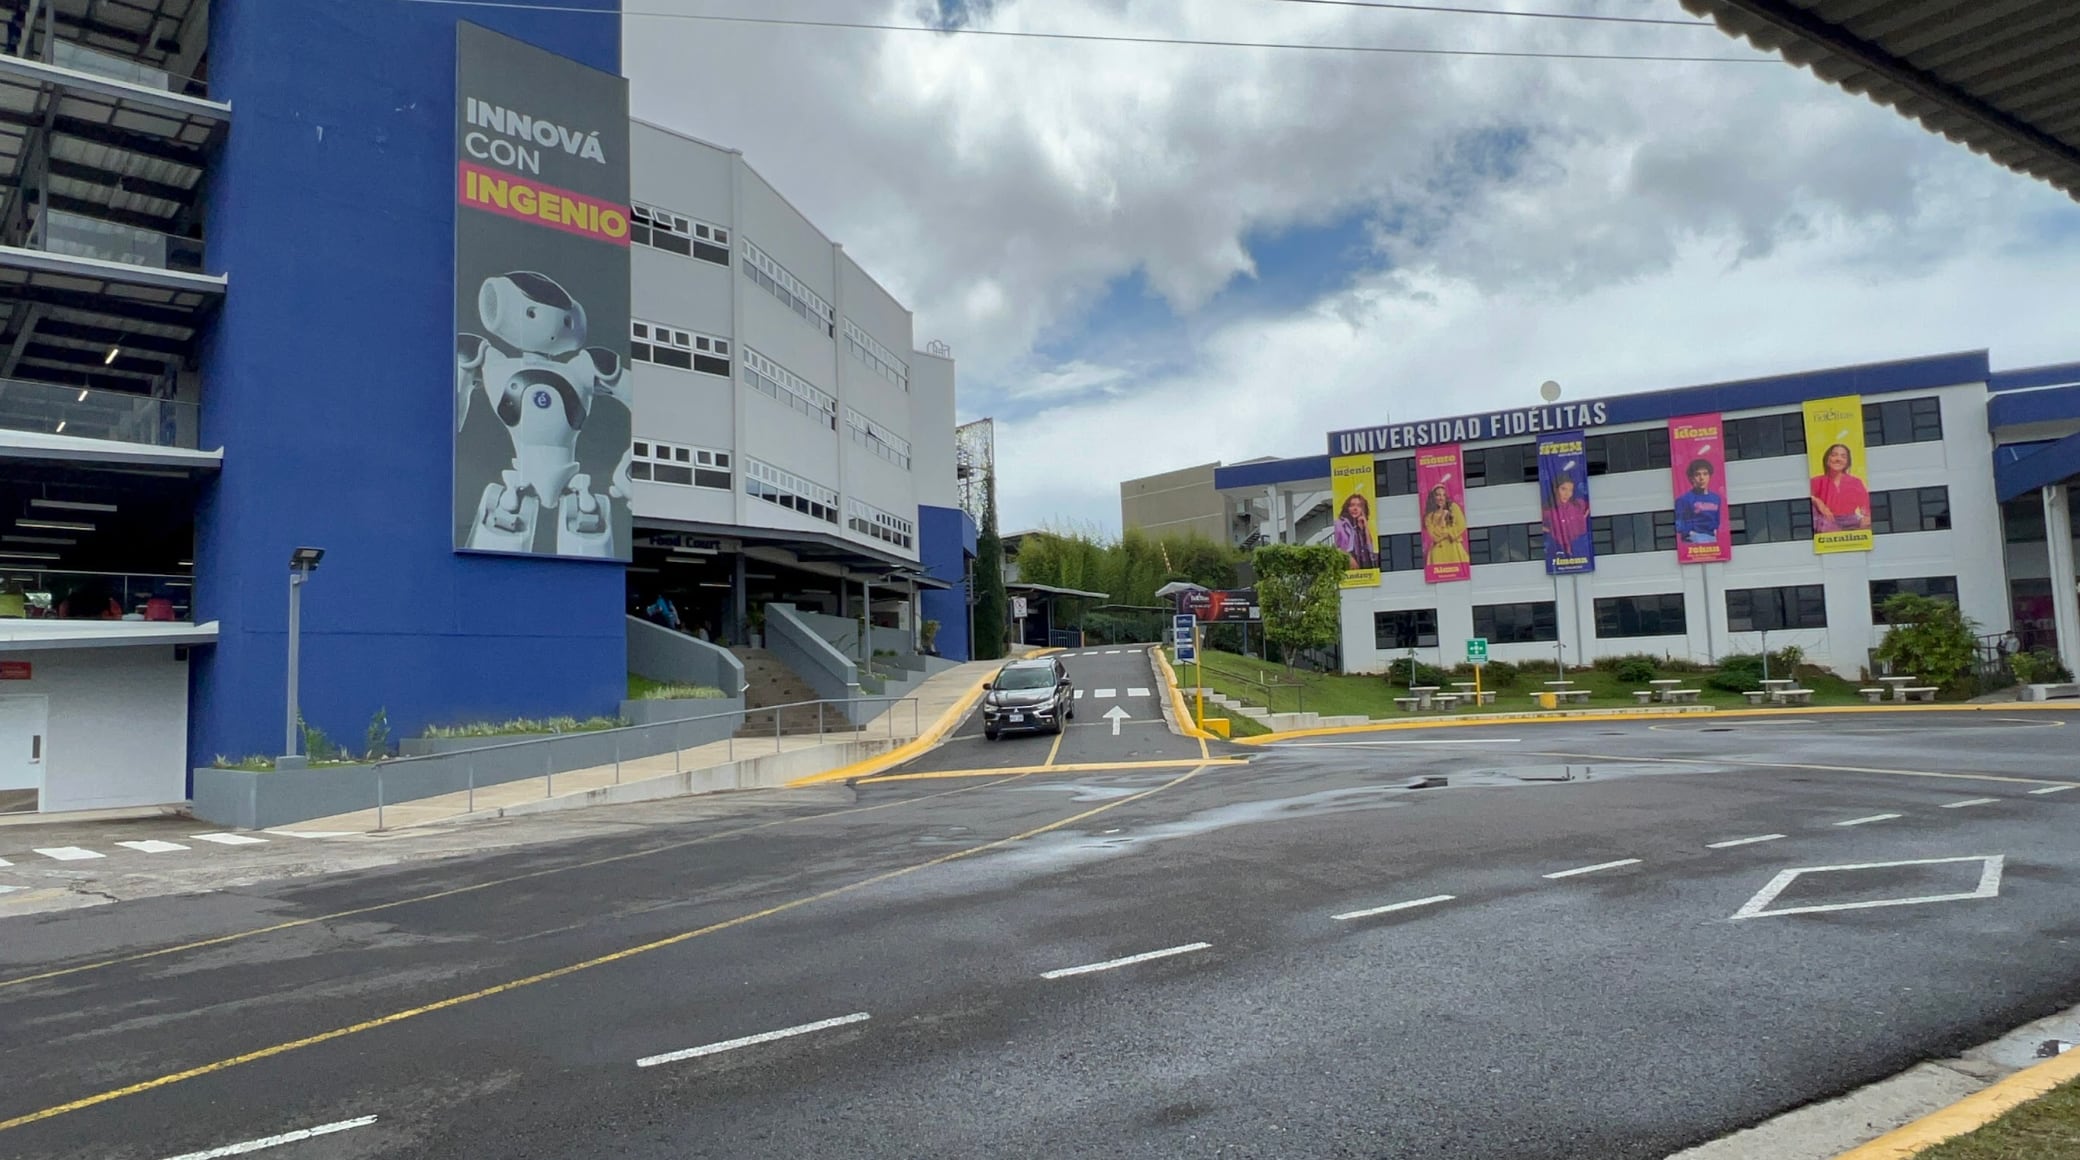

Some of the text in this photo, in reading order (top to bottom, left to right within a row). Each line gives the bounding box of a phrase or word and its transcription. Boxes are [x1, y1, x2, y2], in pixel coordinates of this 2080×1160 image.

[465, 132, 540, 175] CON
[467, 97, 606, 164] INNOVÁ
[466, 170, 628, 238] INGENIO
[1340, 401, 1607, 455] UNIVERSIDAD FIDÉLITAS
[1333, 465, 1372, 477] ingenio
